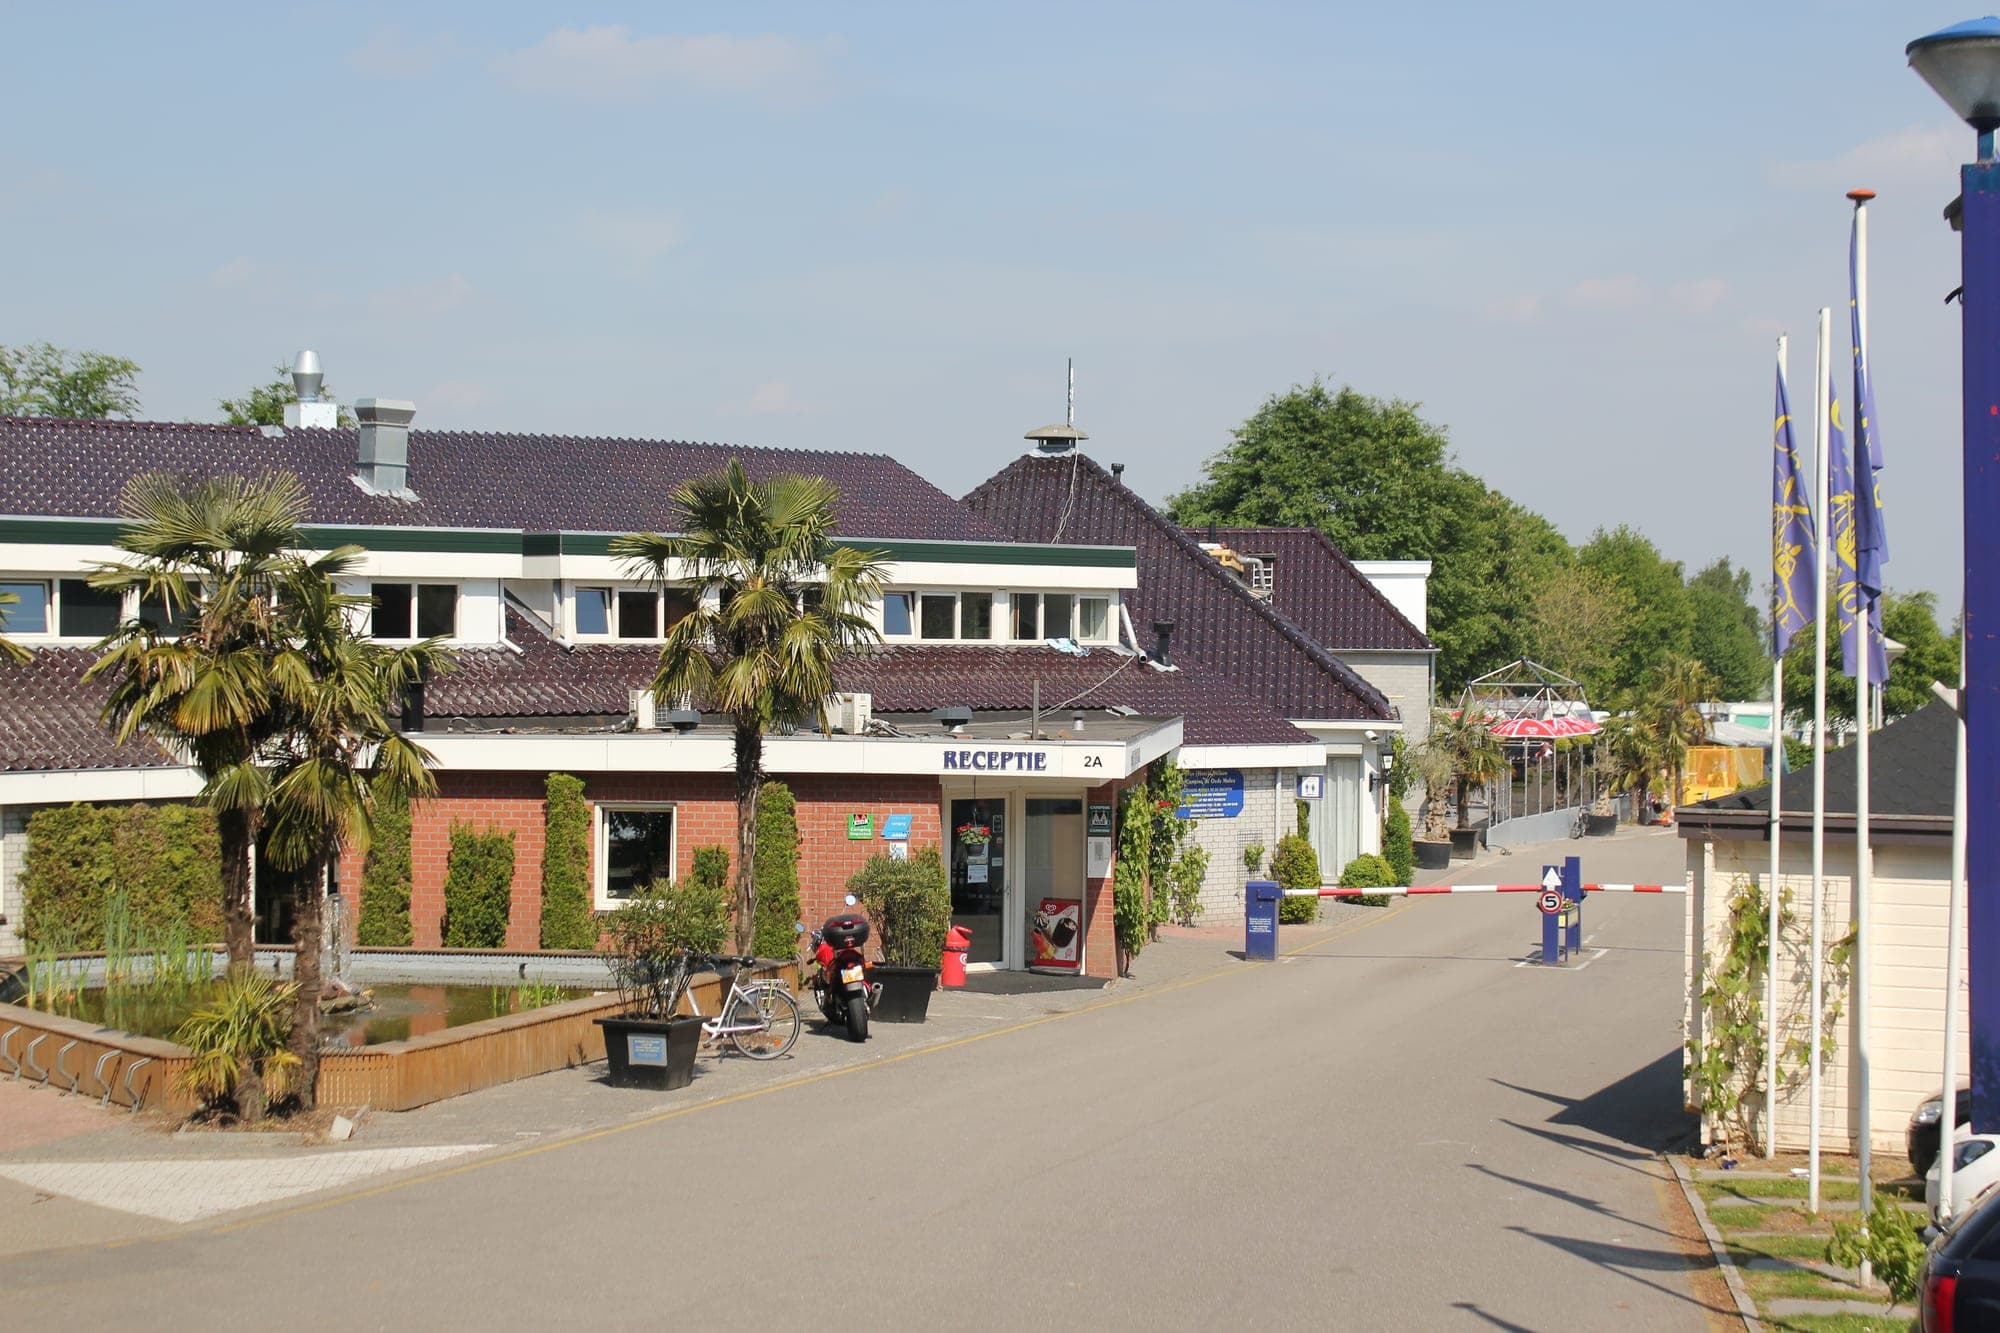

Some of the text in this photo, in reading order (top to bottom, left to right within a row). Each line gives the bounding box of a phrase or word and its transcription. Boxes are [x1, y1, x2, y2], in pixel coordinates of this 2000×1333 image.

[943, 751, 1047, 771] RECEPTIE
[1084, 756, 1103, 768] 2A
[1545, 896, 1557, 908] 5
